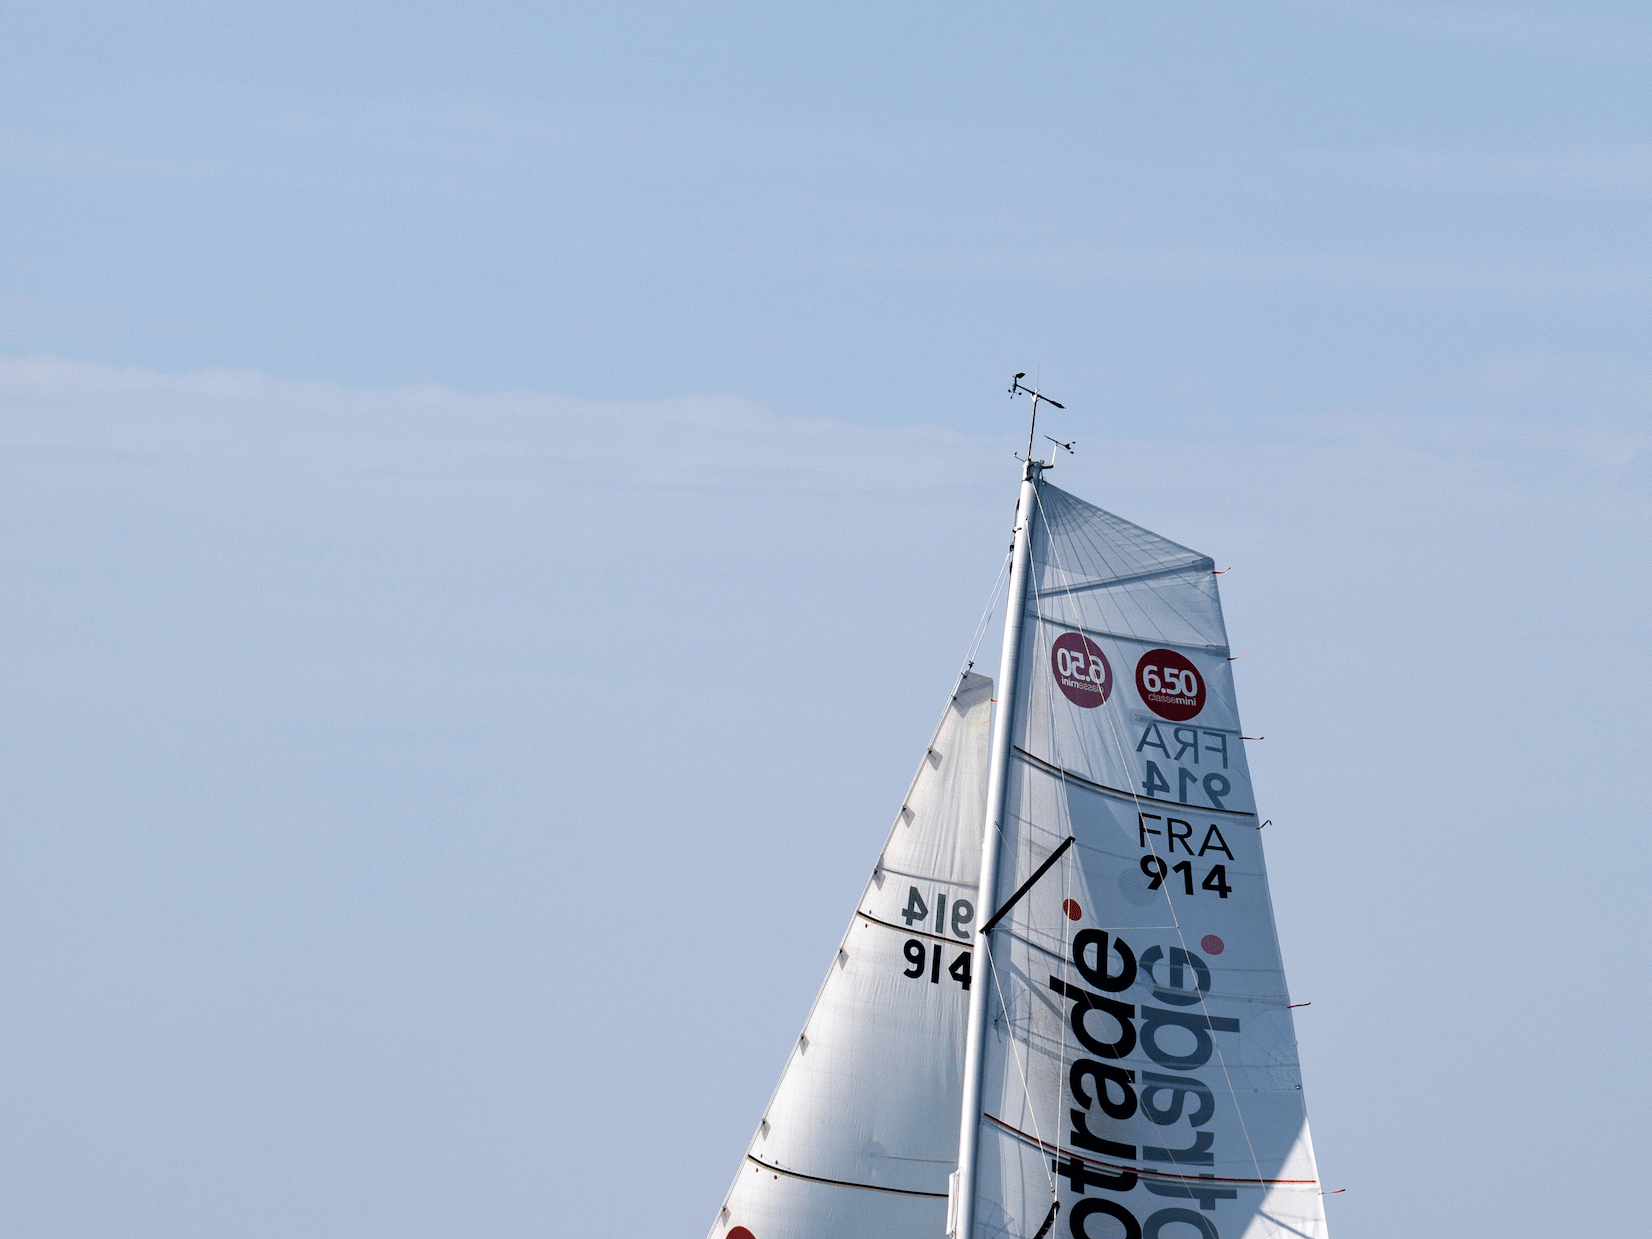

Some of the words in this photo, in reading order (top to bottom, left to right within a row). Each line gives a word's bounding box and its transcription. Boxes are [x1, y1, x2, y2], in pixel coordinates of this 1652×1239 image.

[1142, 665, 1198, 697] 6.50
[1148, 692, 1197, 707] classemini
[1138, 812, 1235, 861] FRA
[1139, 854, 1232, 899] 914
[903, 939, 972, 991] 914
